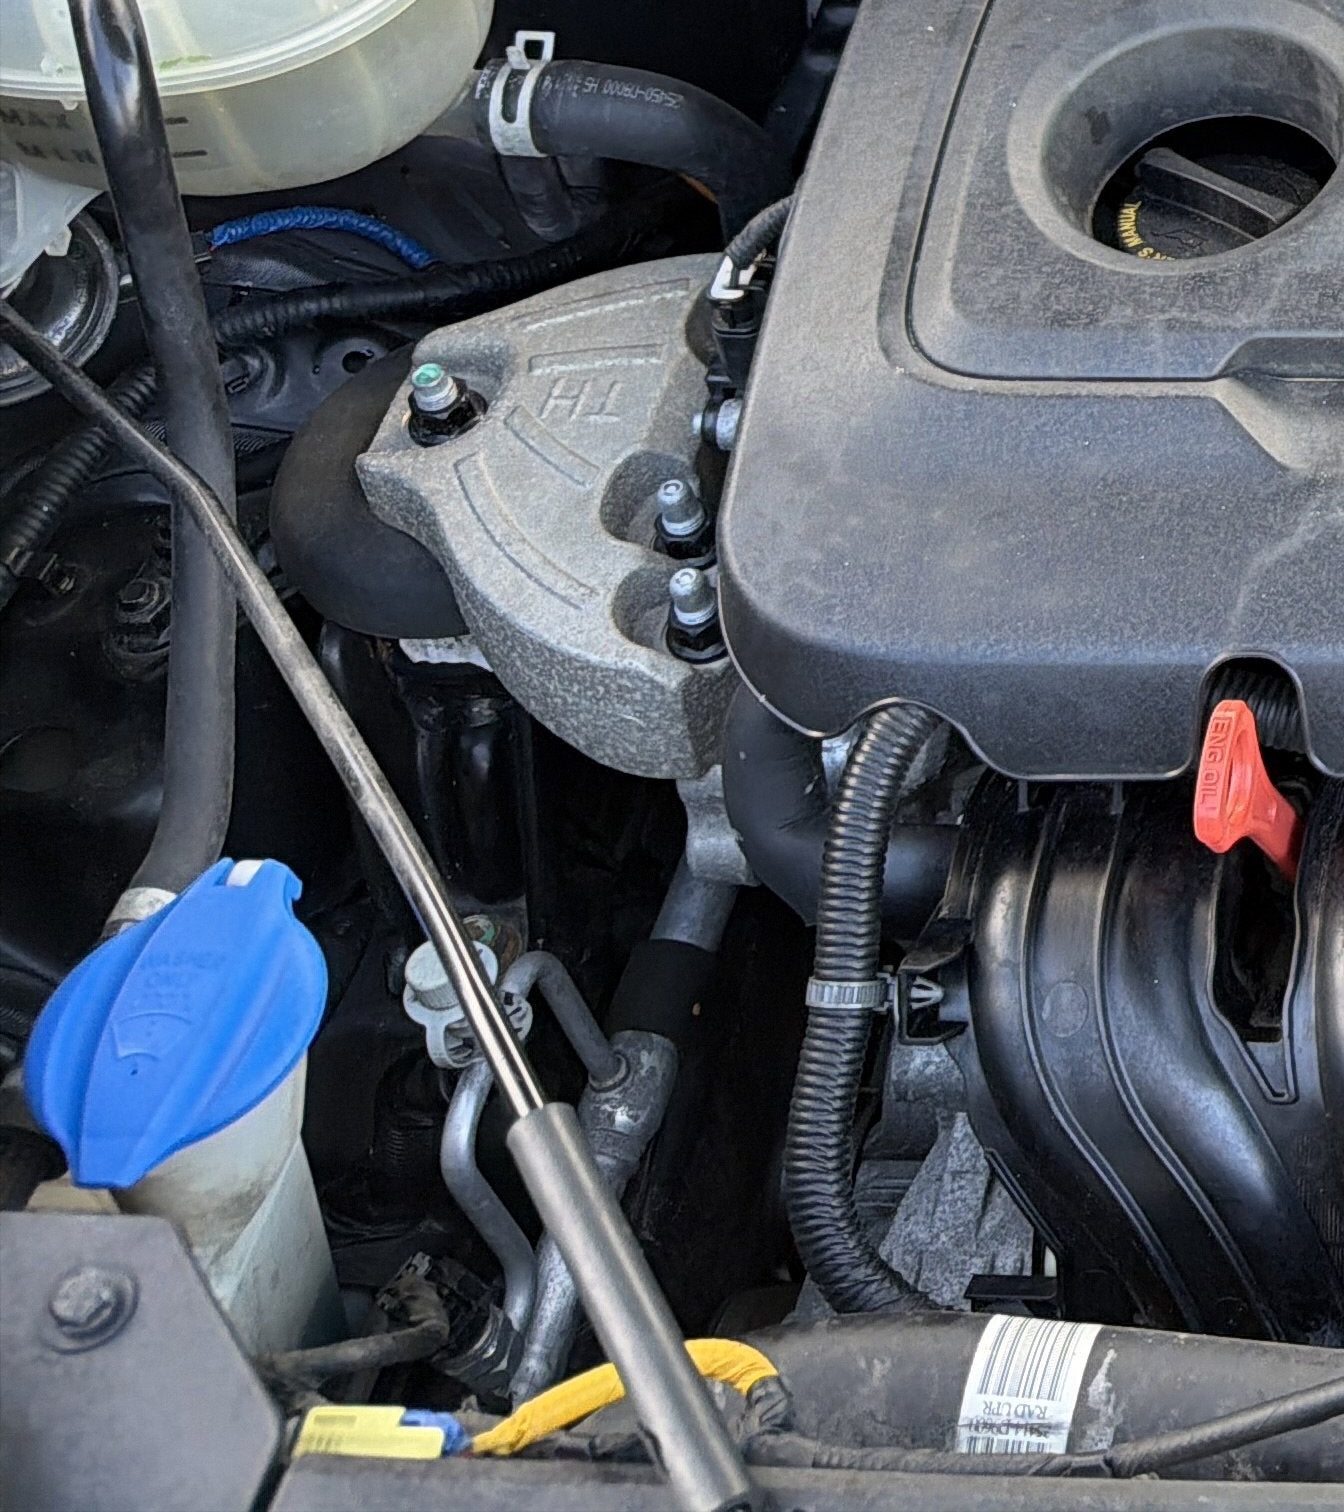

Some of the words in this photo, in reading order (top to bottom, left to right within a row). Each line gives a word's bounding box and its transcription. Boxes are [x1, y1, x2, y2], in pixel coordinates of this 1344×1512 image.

[1117, 200, 1142, 248] MANUAL
[1205, 716, 1233, 764] ENG
[1200, 769, 1220, 805] OIL
[982, 1400, 1012, 1417] UPR
[1014, 1403, 1048, 1420] RAD
